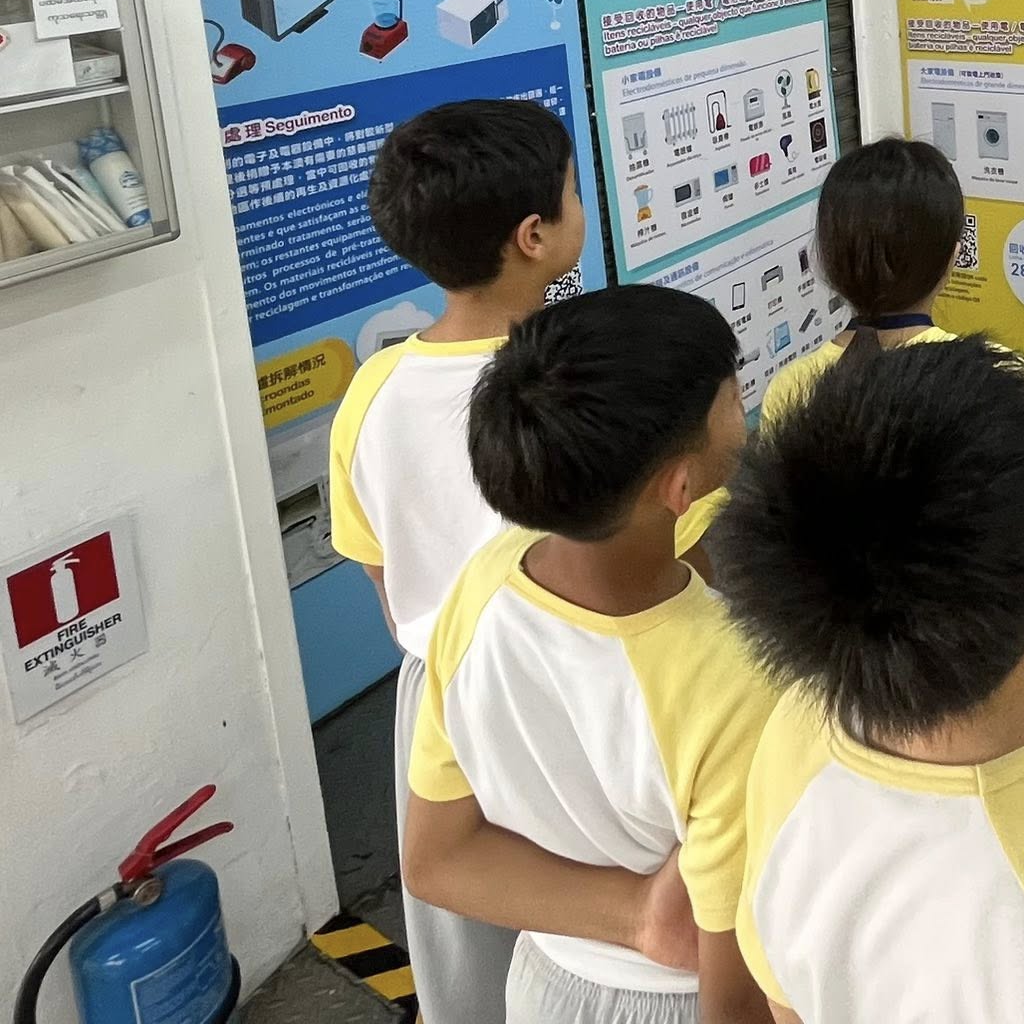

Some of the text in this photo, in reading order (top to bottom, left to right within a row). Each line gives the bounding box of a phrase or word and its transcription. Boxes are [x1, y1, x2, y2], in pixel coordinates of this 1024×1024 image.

[604, 40, 636, 55] bateria
[225, 107, 352, 144] 處理 Seguimento
[287, 196, 345, 219] electrónicos
[276, 224, 296, 237] que
[298, 209, 348, 229] satisfaçam
[288, 223, 343, 245] tratamento,
[347, 215, 372, 228] serão
[261, 257, 273, 266] os
[275, 243, 320, 262] restantes
[272, 255, 321, 277] processos
[325, 249, 338, 259] de
[264, 280, 277, 291] Os
[280, 266, 325, 287] materiais
[327, 251, 373, 272] recicláveis
[278, 289, 297, 300] dos
[299, 267, 357, 292] movimentos
[255, 297, 310, 322] reciclagem
[319, 272, 384, 300] transformação
[385, 267, 399, 277] em
[261, 377, 311, 402] roondas
[263, 388, 314, 416] montado
[24, 613, 122, 672] EXTINGUISHER
[57, 618, 88, 642] FIRE
